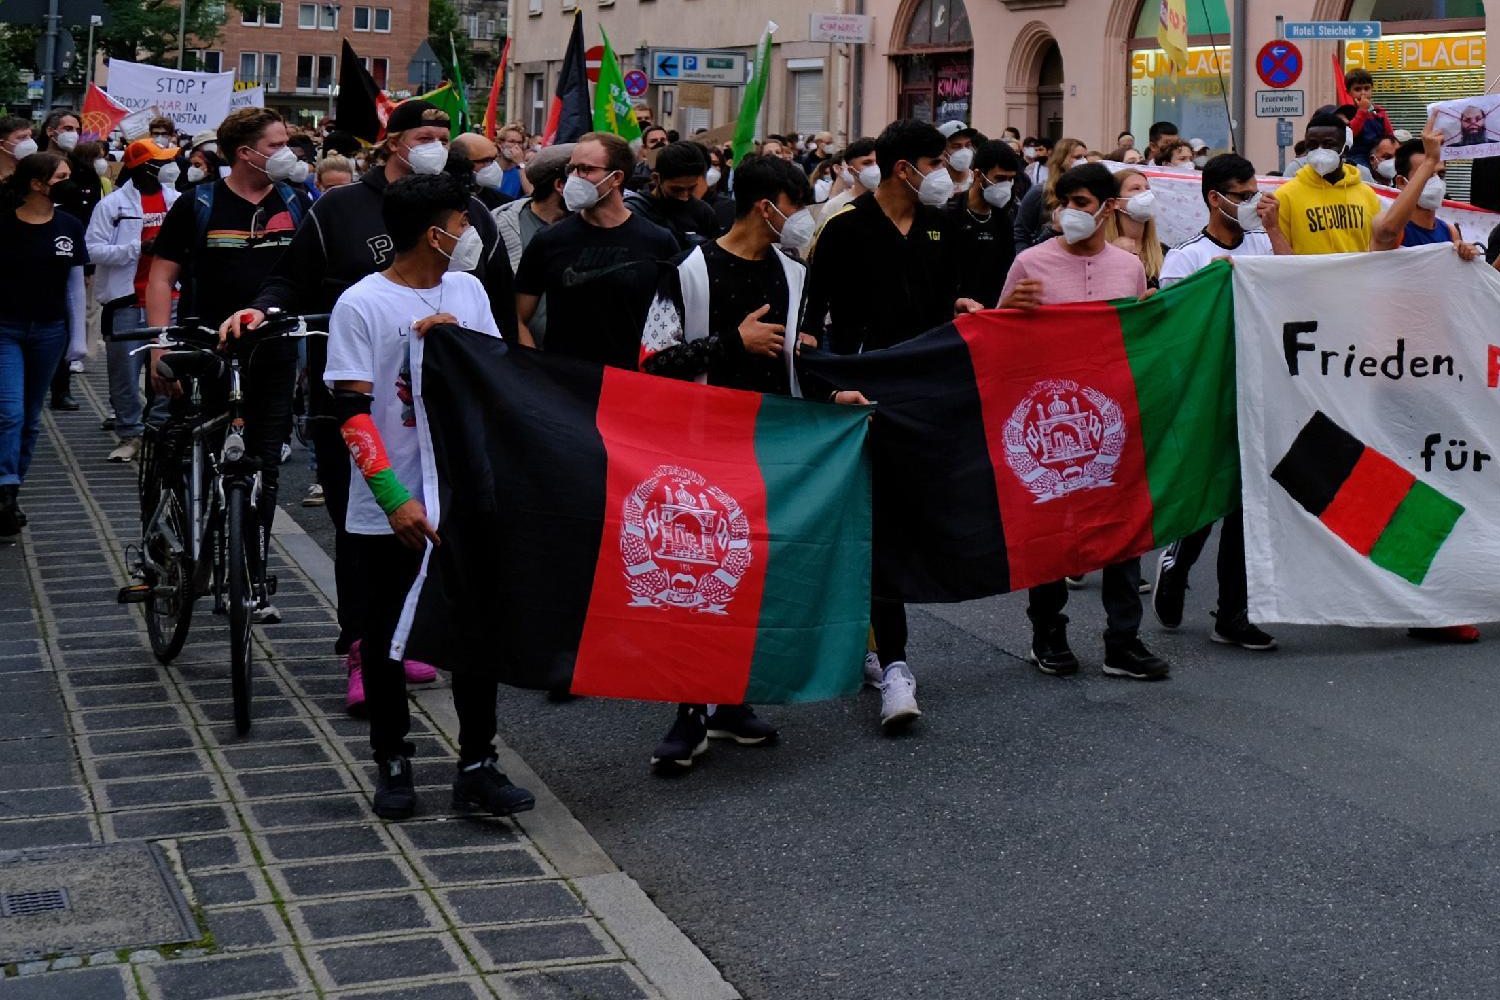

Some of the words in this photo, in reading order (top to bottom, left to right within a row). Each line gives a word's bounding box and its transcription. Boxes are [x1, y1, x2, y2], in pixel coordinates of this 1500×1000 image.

[1292, 25, 1315, 37] Hotel
[1318, 26, 1356, 37] Steichele
[156, 77, 196, 94] STOP
[185, 102, 197, 112] IN
[1305, 203, 1364, 233] SECURITY
[365, 233, 394, 265] P
[1283, 320, 1464, 383] Frieden,
[1420, 433, 1492, 473] für
